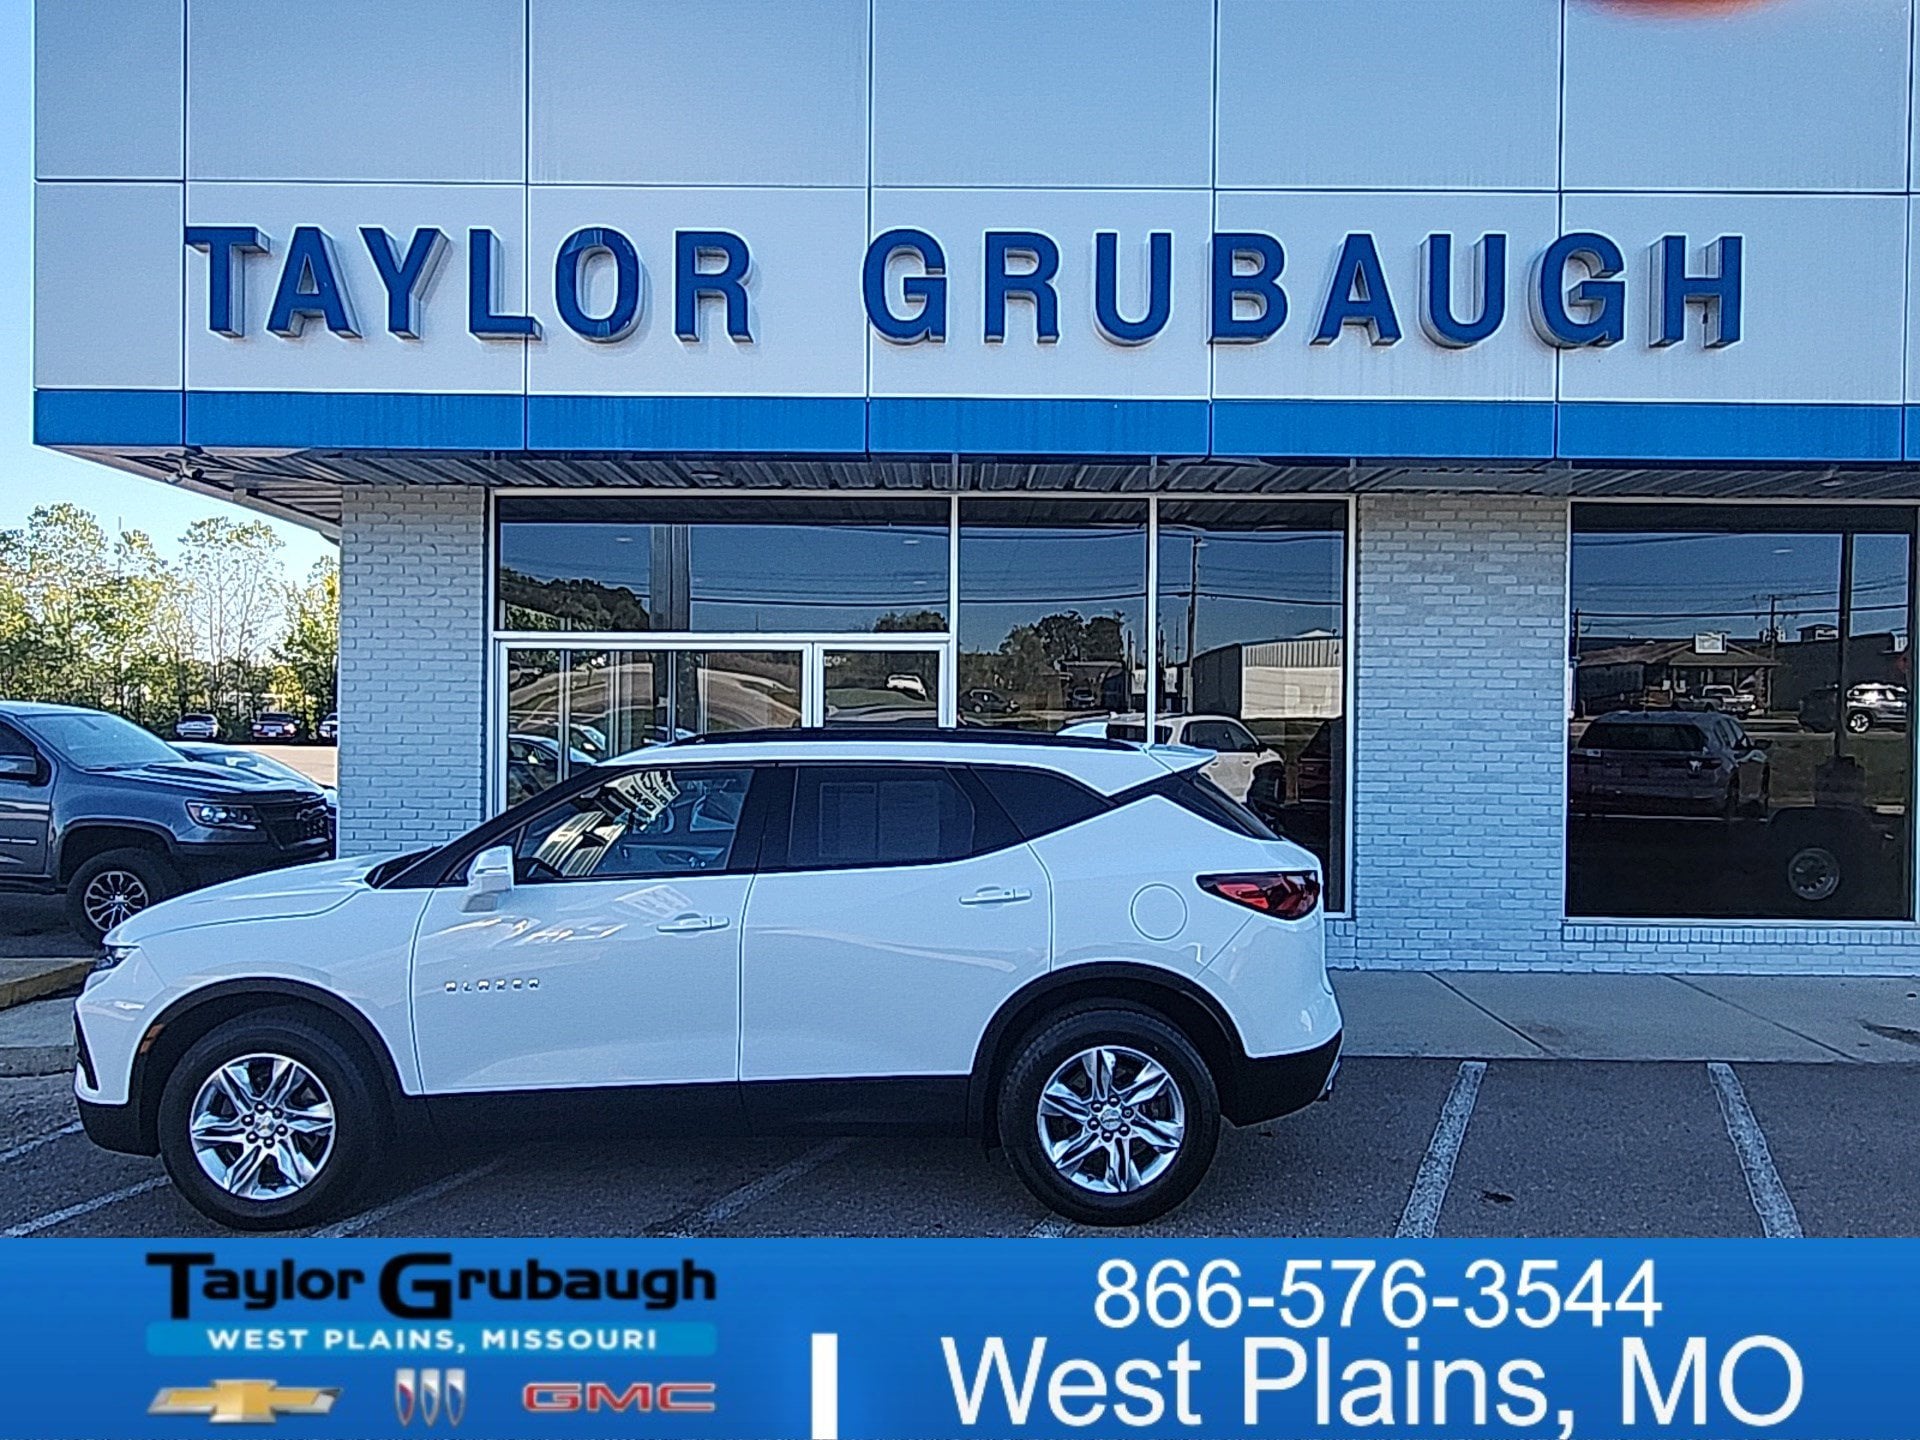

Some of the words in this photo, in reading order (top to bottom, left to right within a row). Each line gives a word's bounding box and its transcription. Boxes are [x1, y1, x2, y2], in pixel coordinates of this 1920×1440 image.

[185, 226, 756, 342] TAYLOR
[863, 228, 1744, 348] GRUBAUGH
[444, 978, 540, 992] BLAZER
